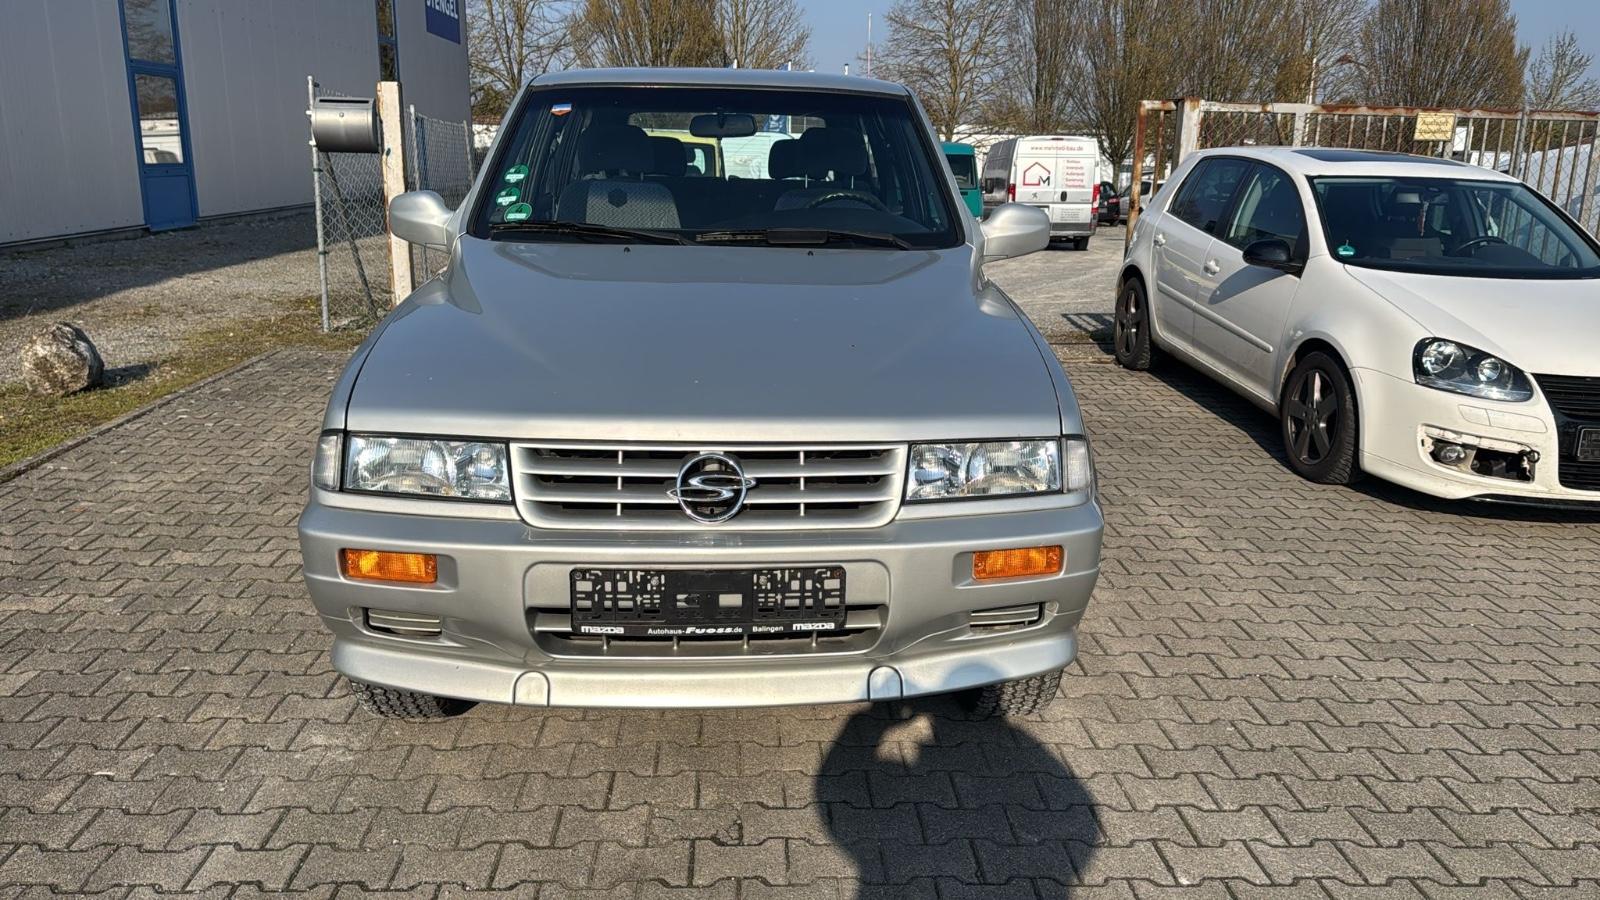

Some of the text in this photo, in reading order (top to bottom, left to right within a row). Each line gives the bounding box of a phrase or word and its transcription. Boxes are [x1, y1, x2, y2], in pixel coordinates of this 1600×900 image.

[581, 625, 625, 634] mazda
[752, 625, 784, 633] Balingen
[792, 622, 835, 631] mazda
